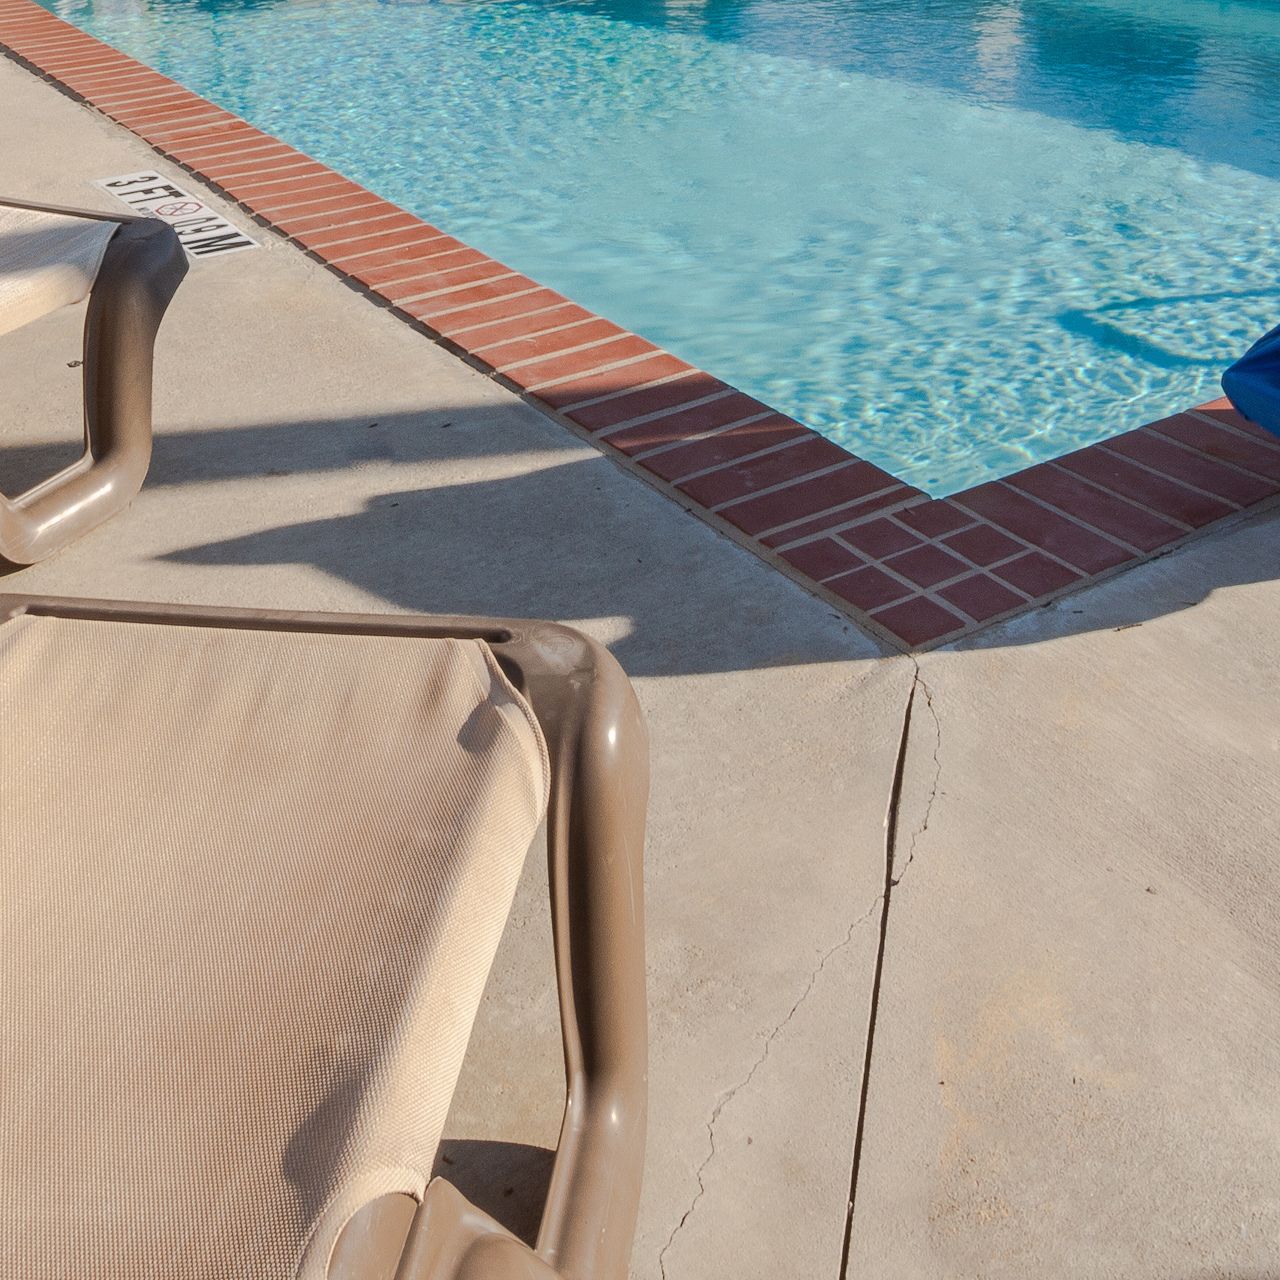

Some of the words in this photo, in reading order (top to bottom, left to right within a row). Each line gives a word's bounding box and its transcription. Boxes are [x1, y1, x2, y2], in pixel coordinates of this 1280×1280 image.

[106, 175, 159, 187] 3
[117, 184, 188, 204] FT
[183, 232, 254, 255] M
